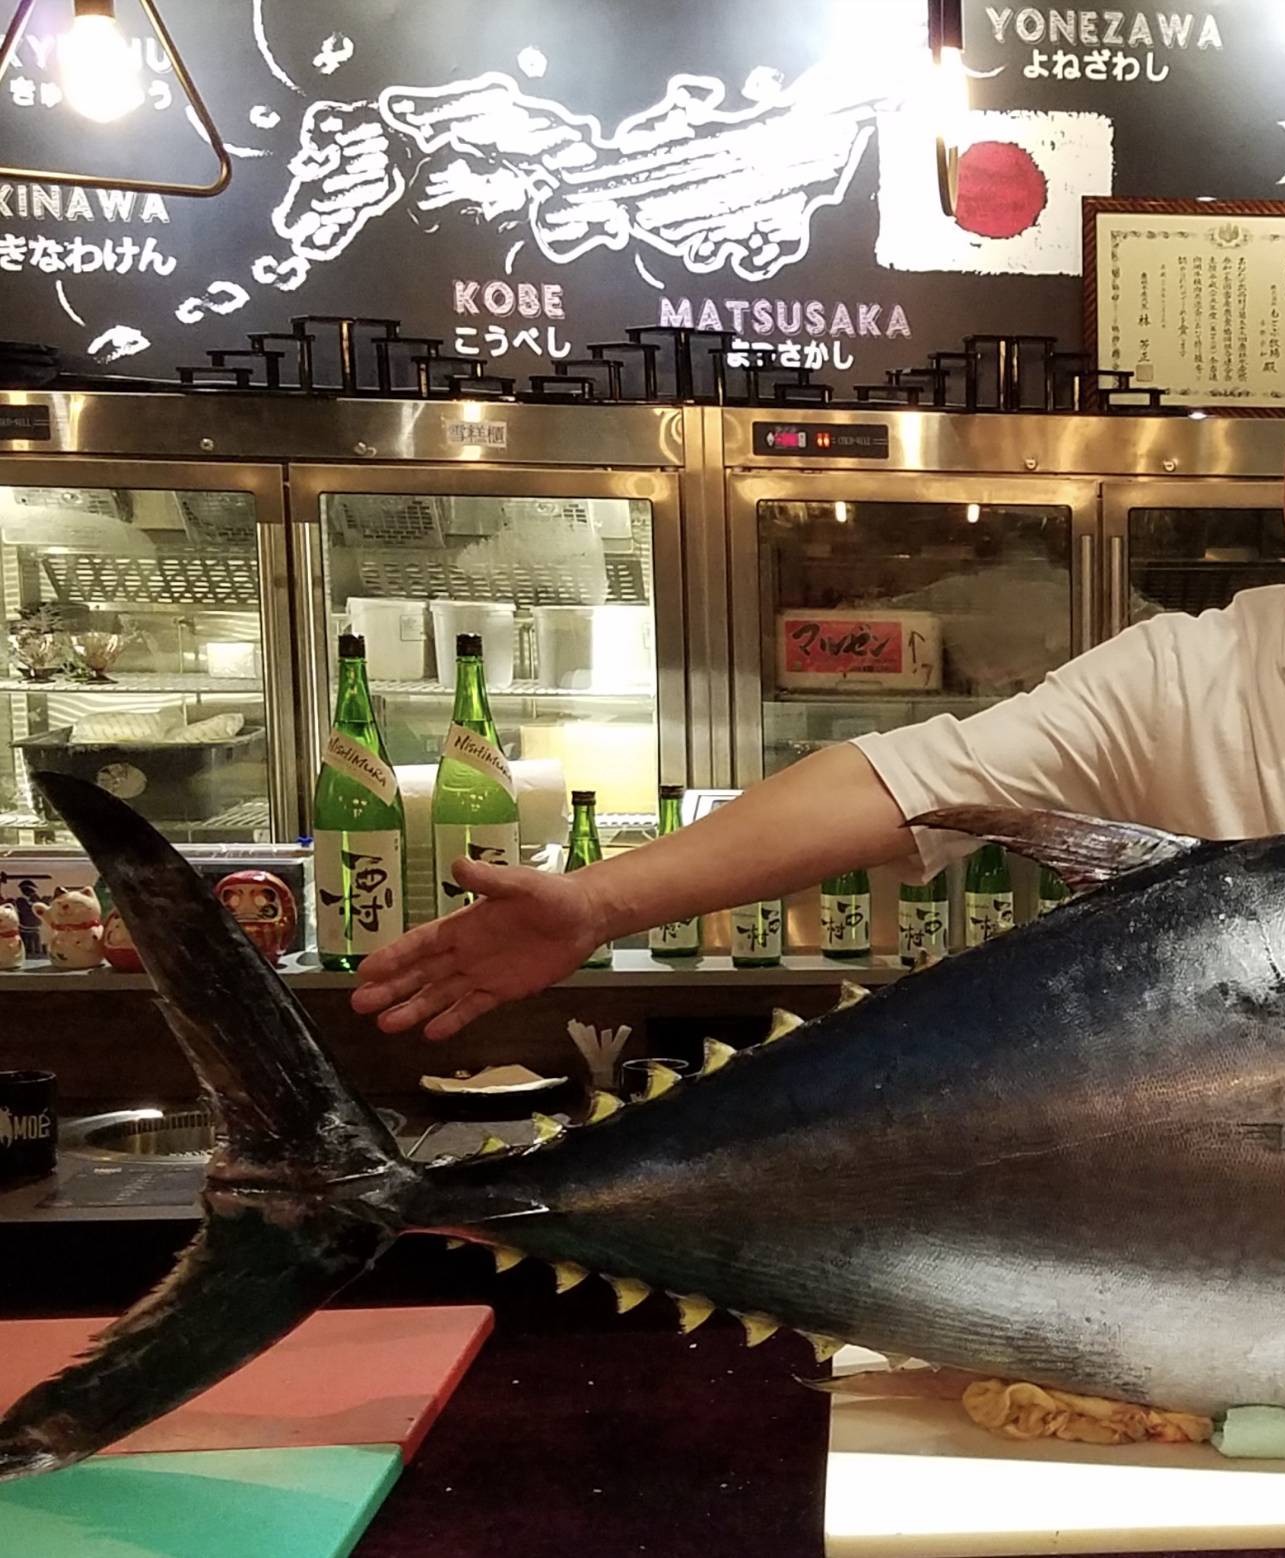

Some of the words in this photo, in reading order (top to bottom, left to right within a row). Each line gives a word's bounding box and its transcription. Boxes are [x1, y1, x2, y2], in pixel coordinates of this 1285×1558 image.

[986, 7, 1223, 50] YONEZAWA
[1023, 49, 1169, 82] よねざわし
[453, 280, 566, 319] KOBE
[659, 297, 912, 339] MATSUSAKA
[455, 325, 571, 358] こうべし
